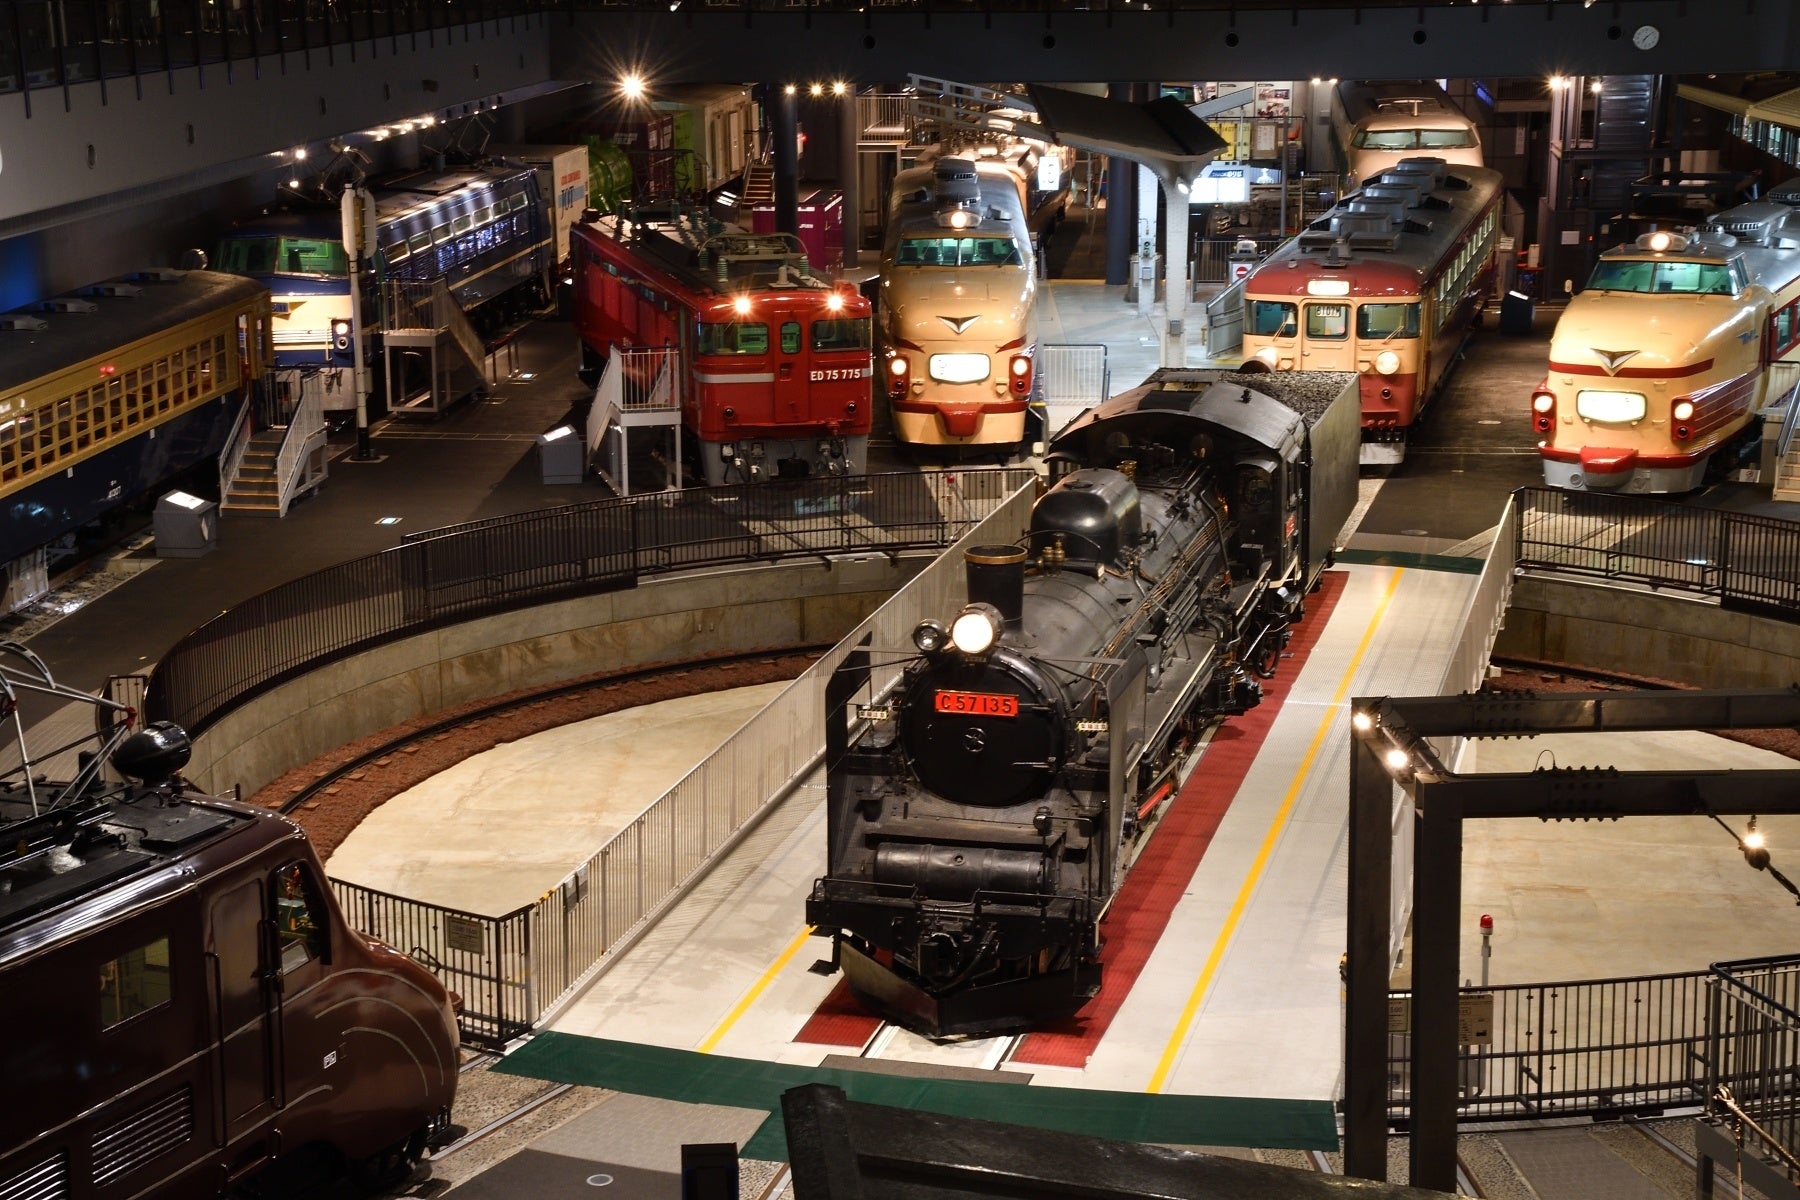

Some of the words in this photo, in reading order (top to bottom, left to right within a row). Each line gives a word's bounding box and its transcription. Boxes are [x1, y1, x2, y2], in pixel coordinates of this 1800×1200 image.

[810, 370, 824, 381] ED
[826, 369, 839, 380] 75
[841, 368, 861, 380] 775
